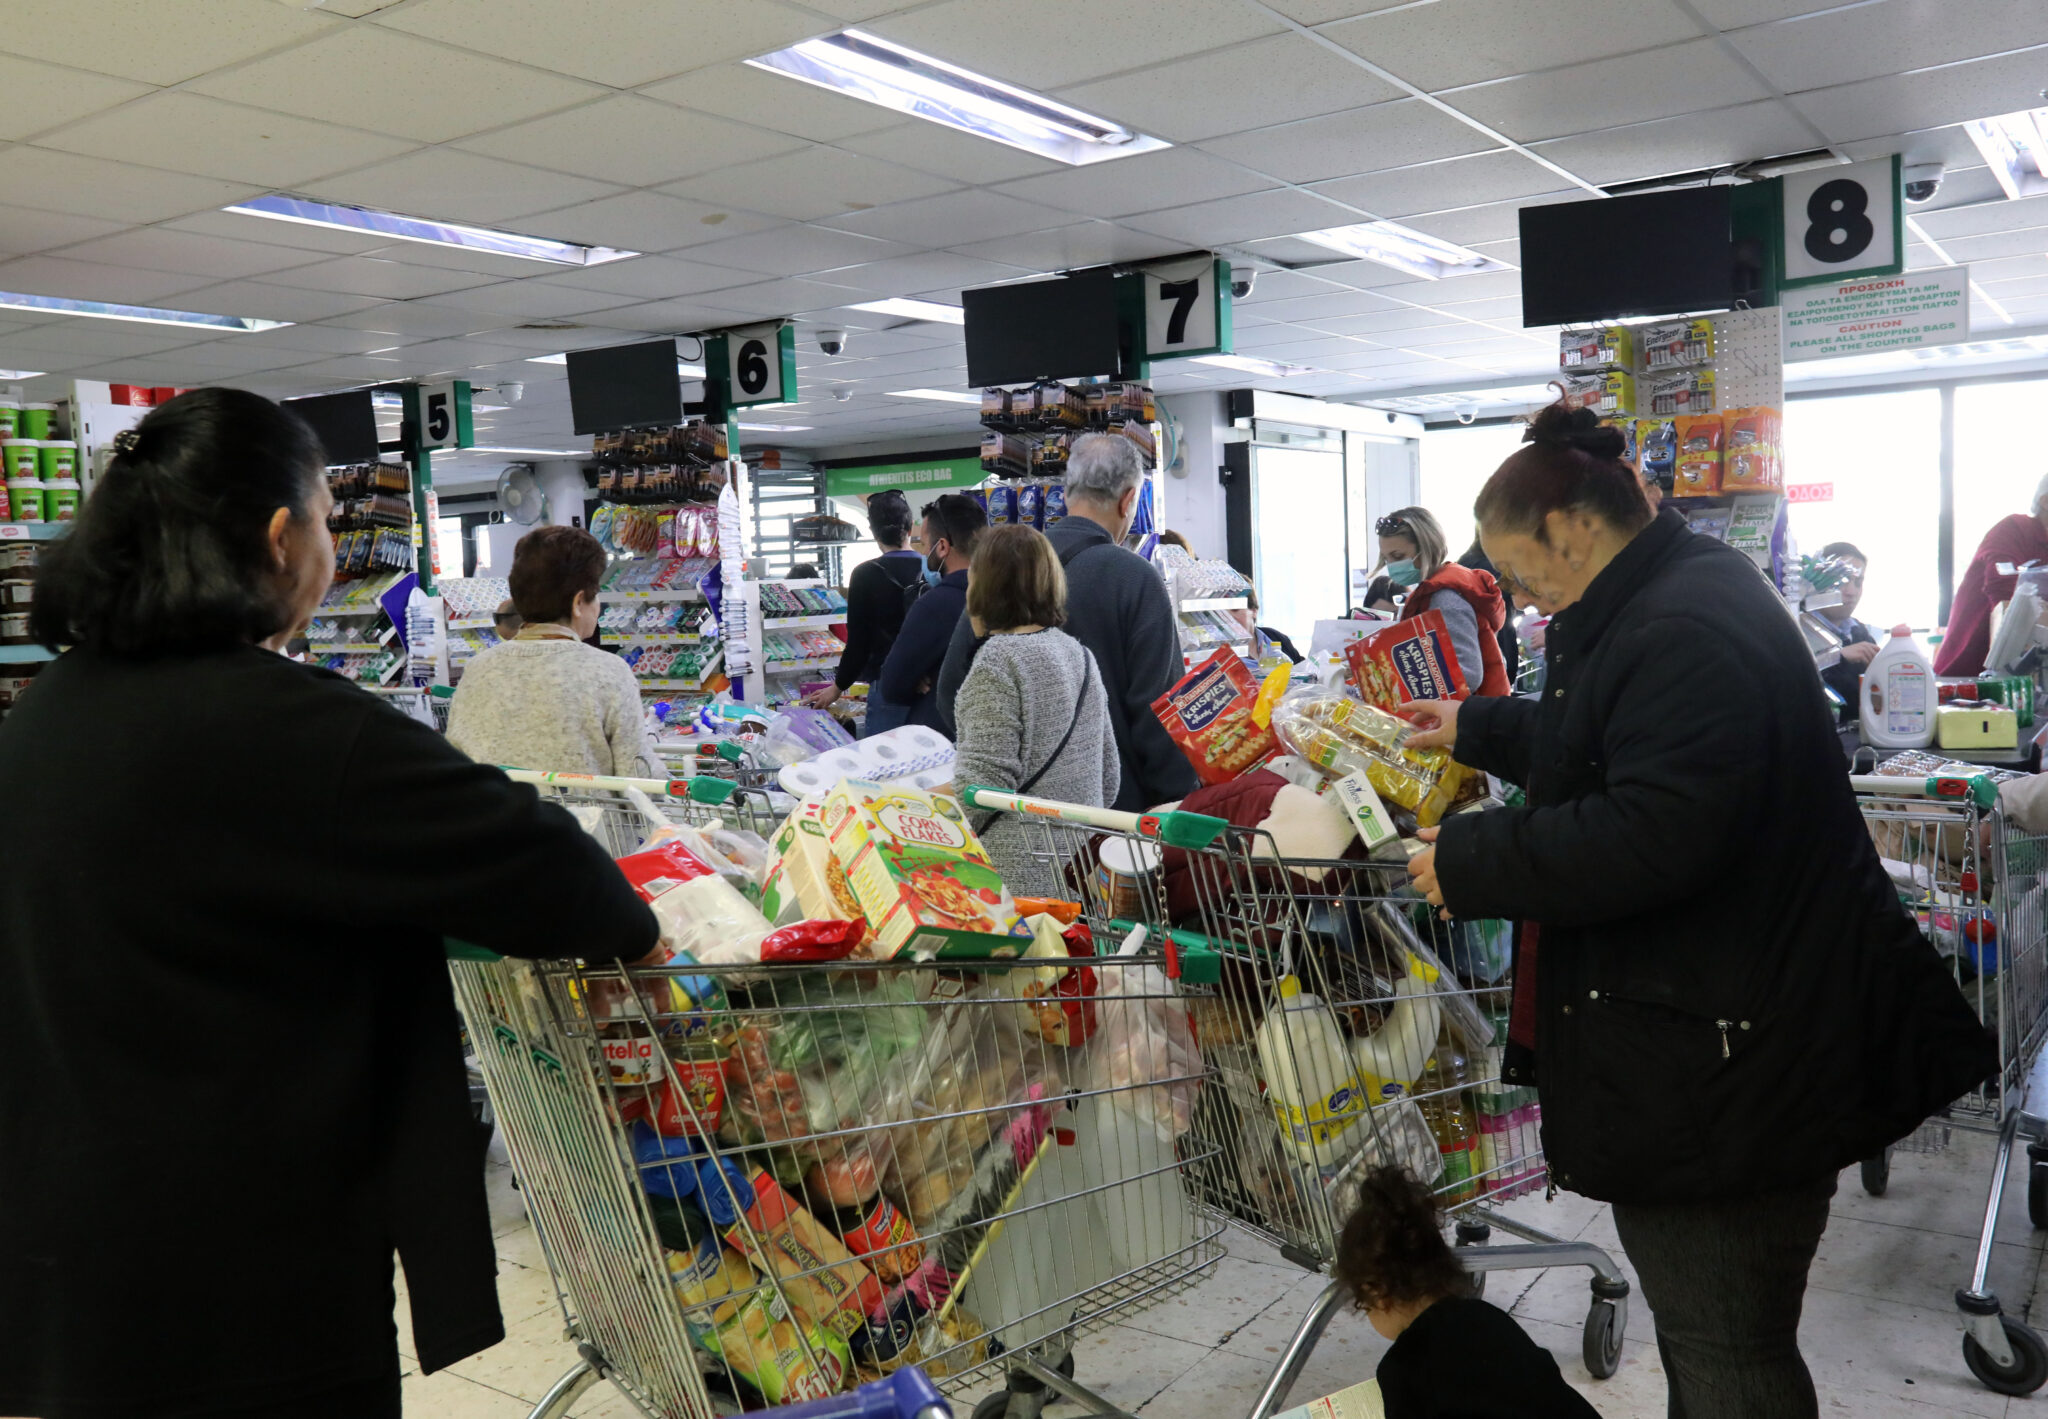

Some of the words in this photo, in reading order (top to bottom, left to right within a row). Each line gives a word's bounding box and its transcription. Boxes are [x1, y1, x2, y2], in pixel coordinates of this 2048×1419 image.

[1804, 178, 1874, 264] 8
[1838, 279, 1905, 295] ΠΡΟΣΟΧΗ
[1829, 295, 1843, 305] ΤΑ
[1160, 278, 1199, 344] 7
[1789, 318, 1803, 327] ΝΑ
[1838, 319, 1903, 334] CAUTION
[1646, 328, 1680, 347] Energizer
[1789, 336, 1832, 349] PLEASE
[1835, 334, 1857, 344] ALL
[1859, 326, 1920, 341] SHOPPING
[1922, 321, 1956, 333] BAGS
[1820, 344, 1837, 353] ON
[1839, 341, 1863, 351] THE
[1865, 335, 1923, 348] COUNTER
[737, 339, 769, 395] 6
[1652, 377, 1688, 394] Energizer
[427, 392, 450, 442] 5
[915, 468, 933, 483] ECO
[933, 467, 953, 481] BAG
[1406, 642, 1433, 696] KRISPIES
[1184, 681, 1226, 720] KRISPIES
[898, 814, 944, 833] CORN
[900, 826, 955, 846] FLAKES
